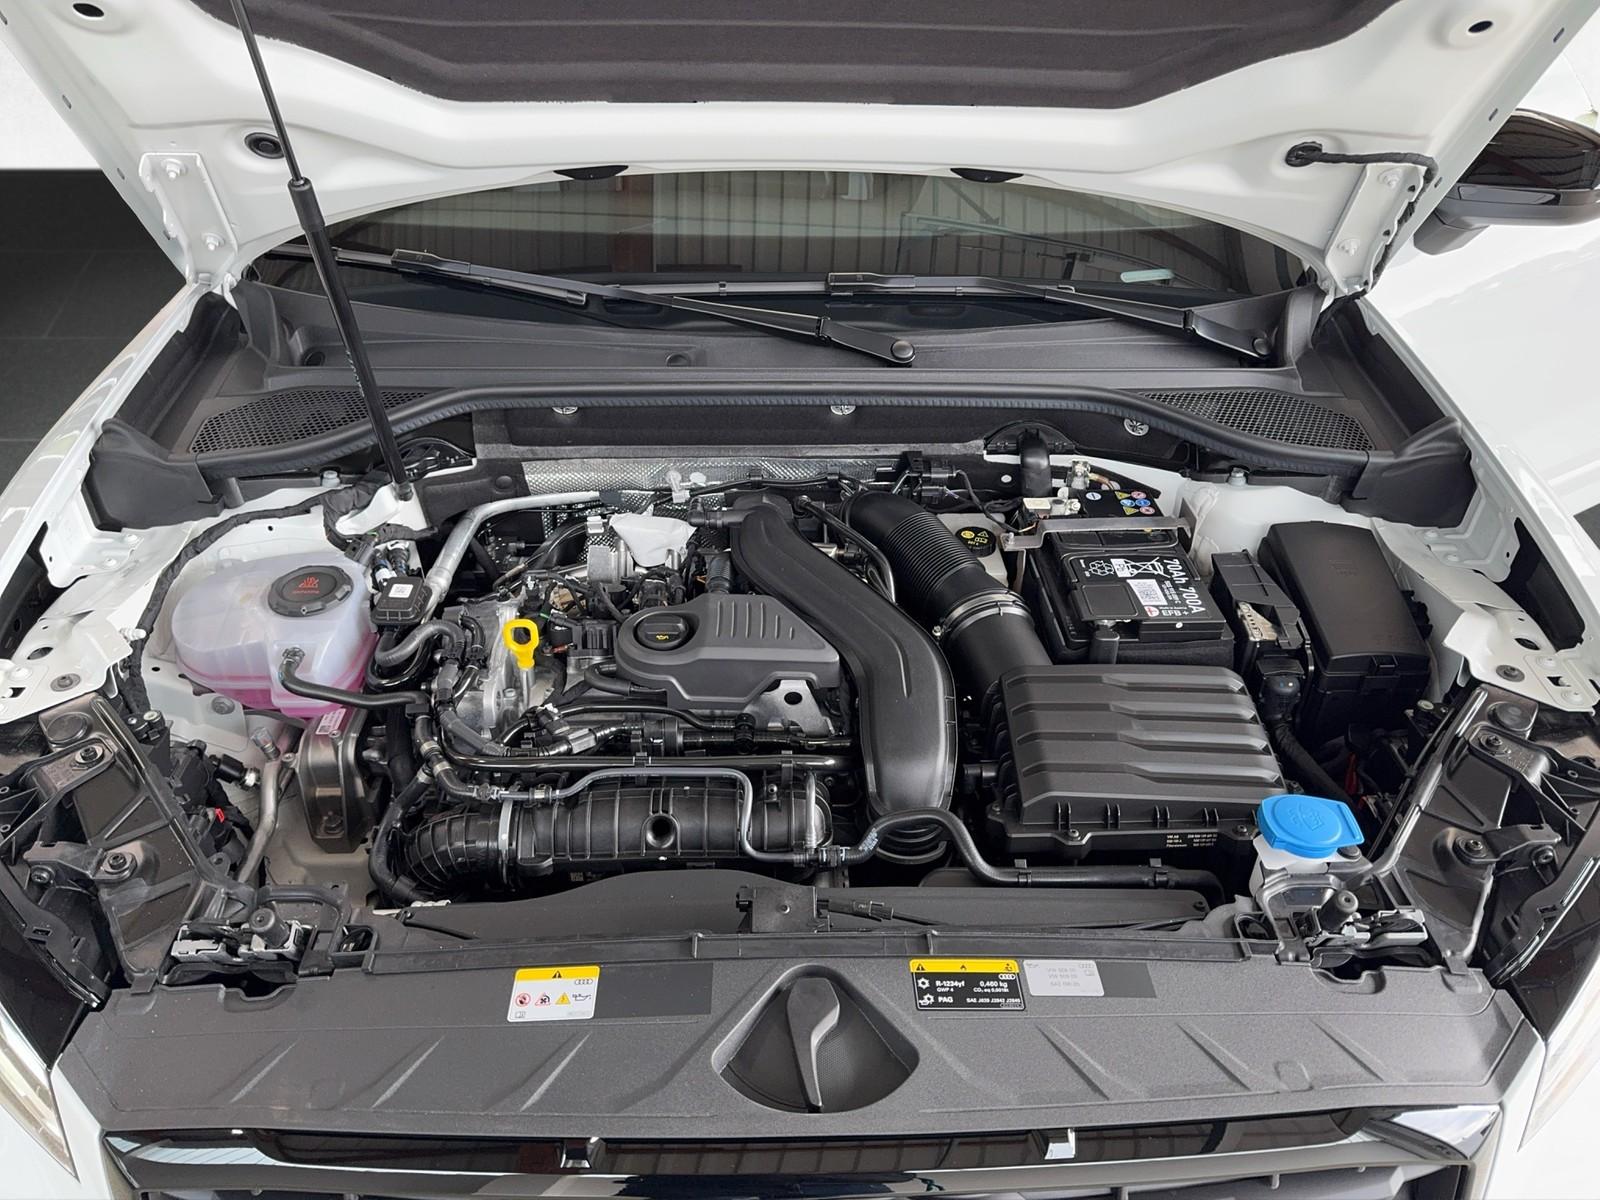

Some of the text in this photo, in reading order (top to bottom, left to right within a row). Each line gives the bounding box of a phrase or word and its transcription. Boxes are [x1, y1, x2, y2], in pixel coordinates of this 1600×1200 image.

[1163, 558, 1189, 583] 70Ah
[1179, 586, 1206, 613] 700A
[935, 980, 965, 988] R-1234yf
[999, 980, 1008, 989] kg
